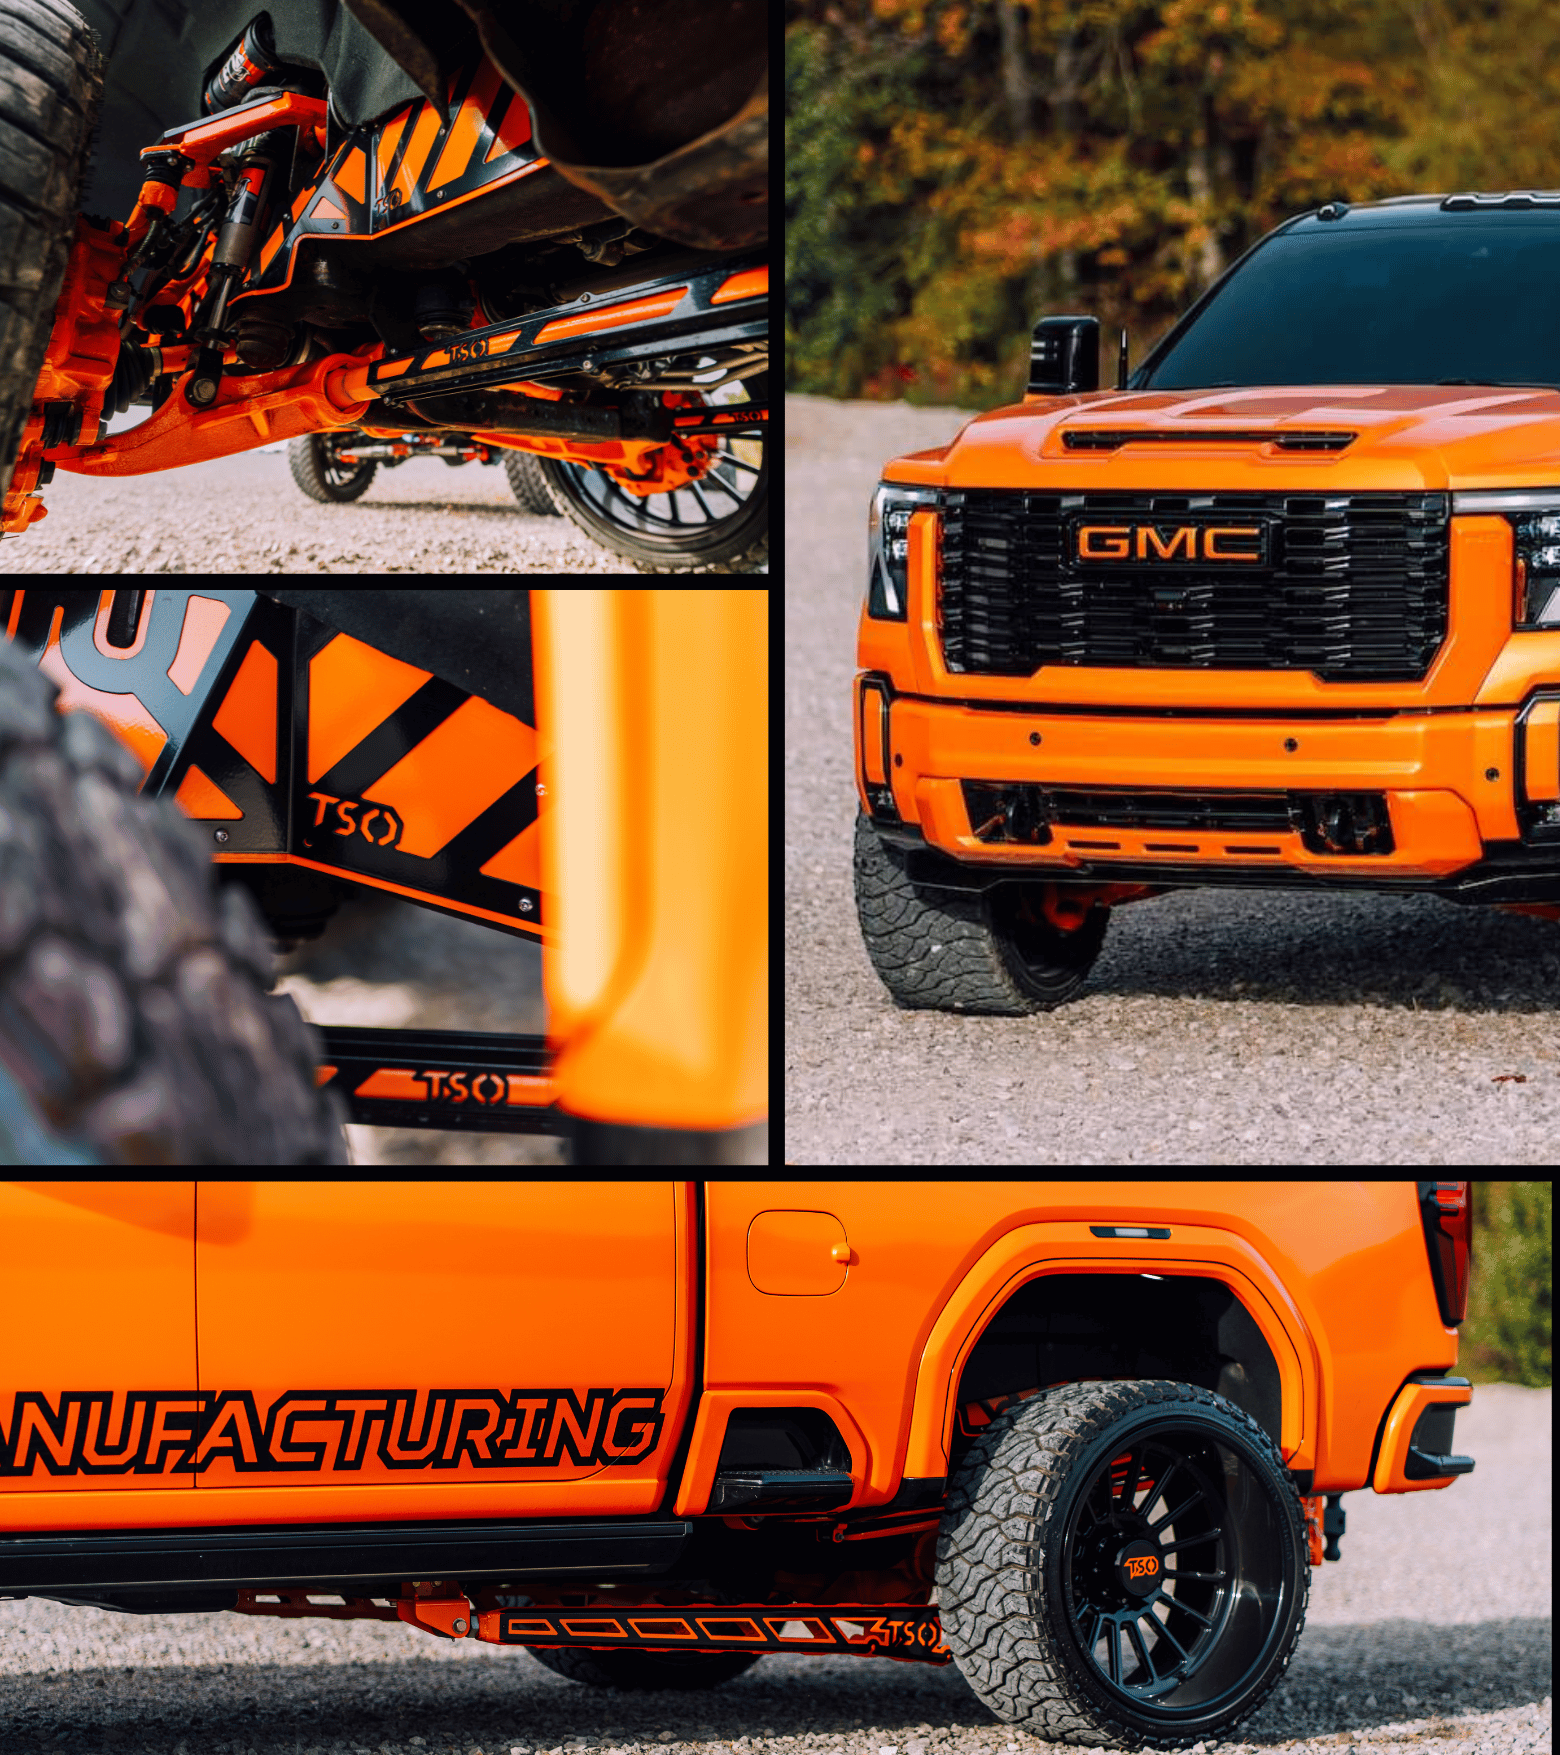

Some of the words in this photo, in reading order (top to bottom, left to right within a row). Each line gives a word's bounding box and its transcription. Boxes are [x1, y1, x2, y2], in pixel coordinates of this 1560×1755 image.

[450, 339, 486, 361] TSO
[731, 411, 761, 422] TSO
[1079, 526, 1260, 560] GMC
[307, 791, 397, 846] TSO
[422, 1070, 505, 1105] TSO
[0, 1386, 666, 1477] NUFACTURING
[1124, 1555, 1159, 1580] TSO
[886, 1620, 937, 1647] TSO
